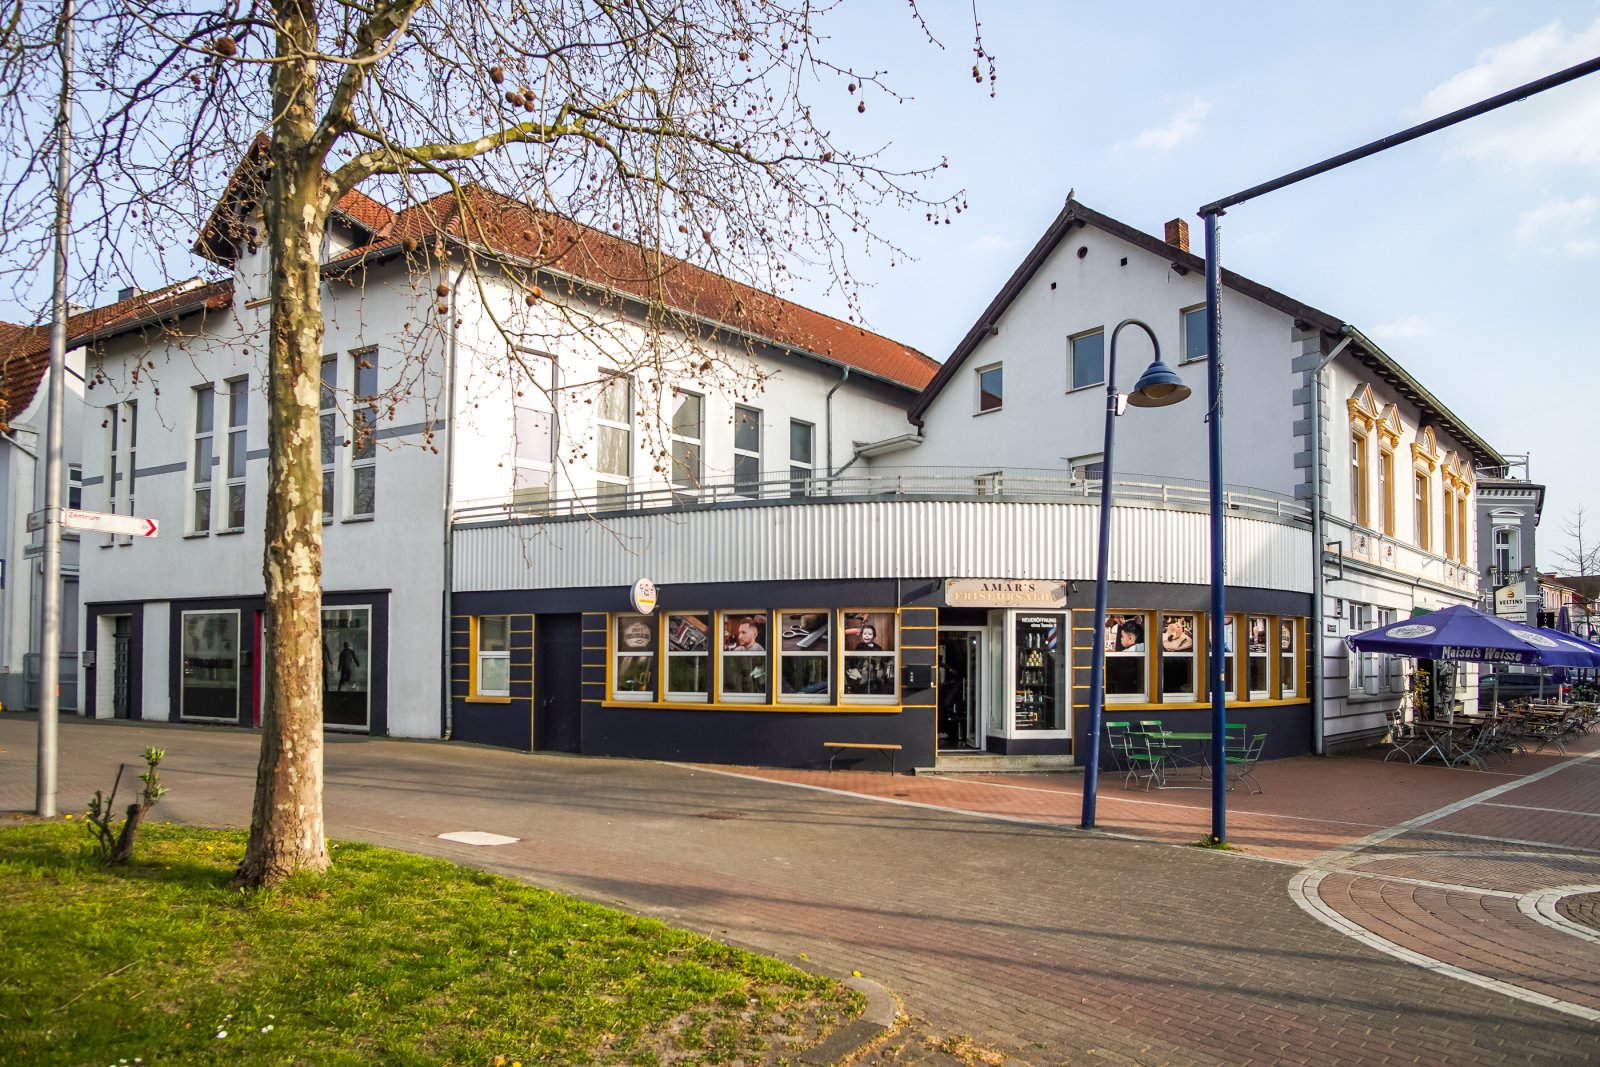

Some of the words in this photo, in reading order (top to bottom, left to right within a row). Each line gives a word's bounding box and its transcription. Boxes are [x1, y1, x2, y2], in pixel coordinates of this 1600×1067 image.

[68, 511, 101, 521] Zentrum
[981, 583, 1035, 592] AMAR'S
[1441, 646, 1482, 660] Maisel's
[1484, 647, 1522, 662] Weisse
